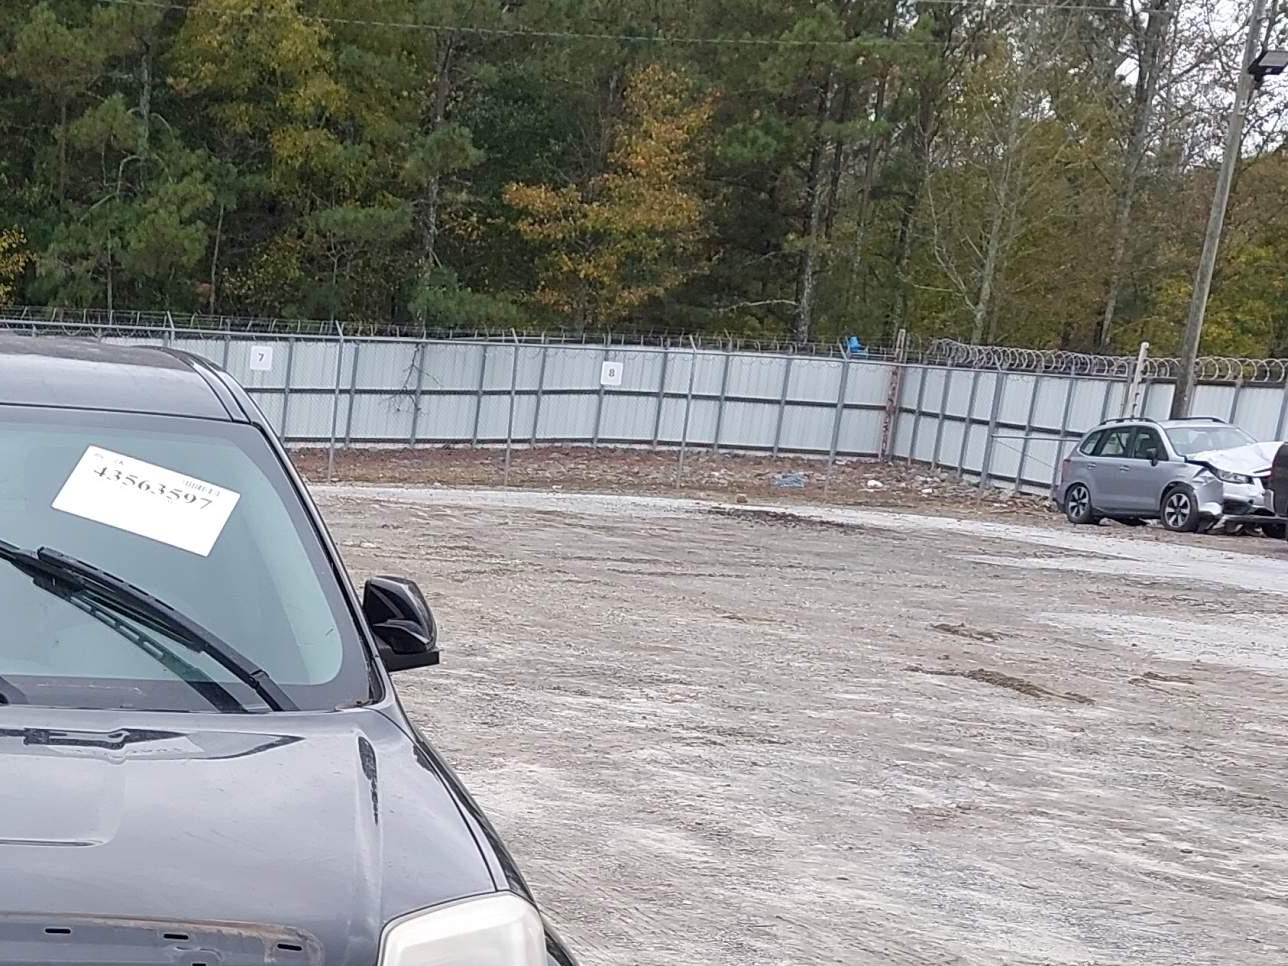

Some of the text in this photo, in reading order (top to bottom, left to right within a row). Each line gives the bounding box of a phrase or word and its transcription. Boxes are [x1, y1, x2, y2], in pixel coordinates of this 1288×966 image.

[257, 352, 265, 362] 7
[608, 367, 616, 378] 8
[93, 466, 213, 510] 43563597
